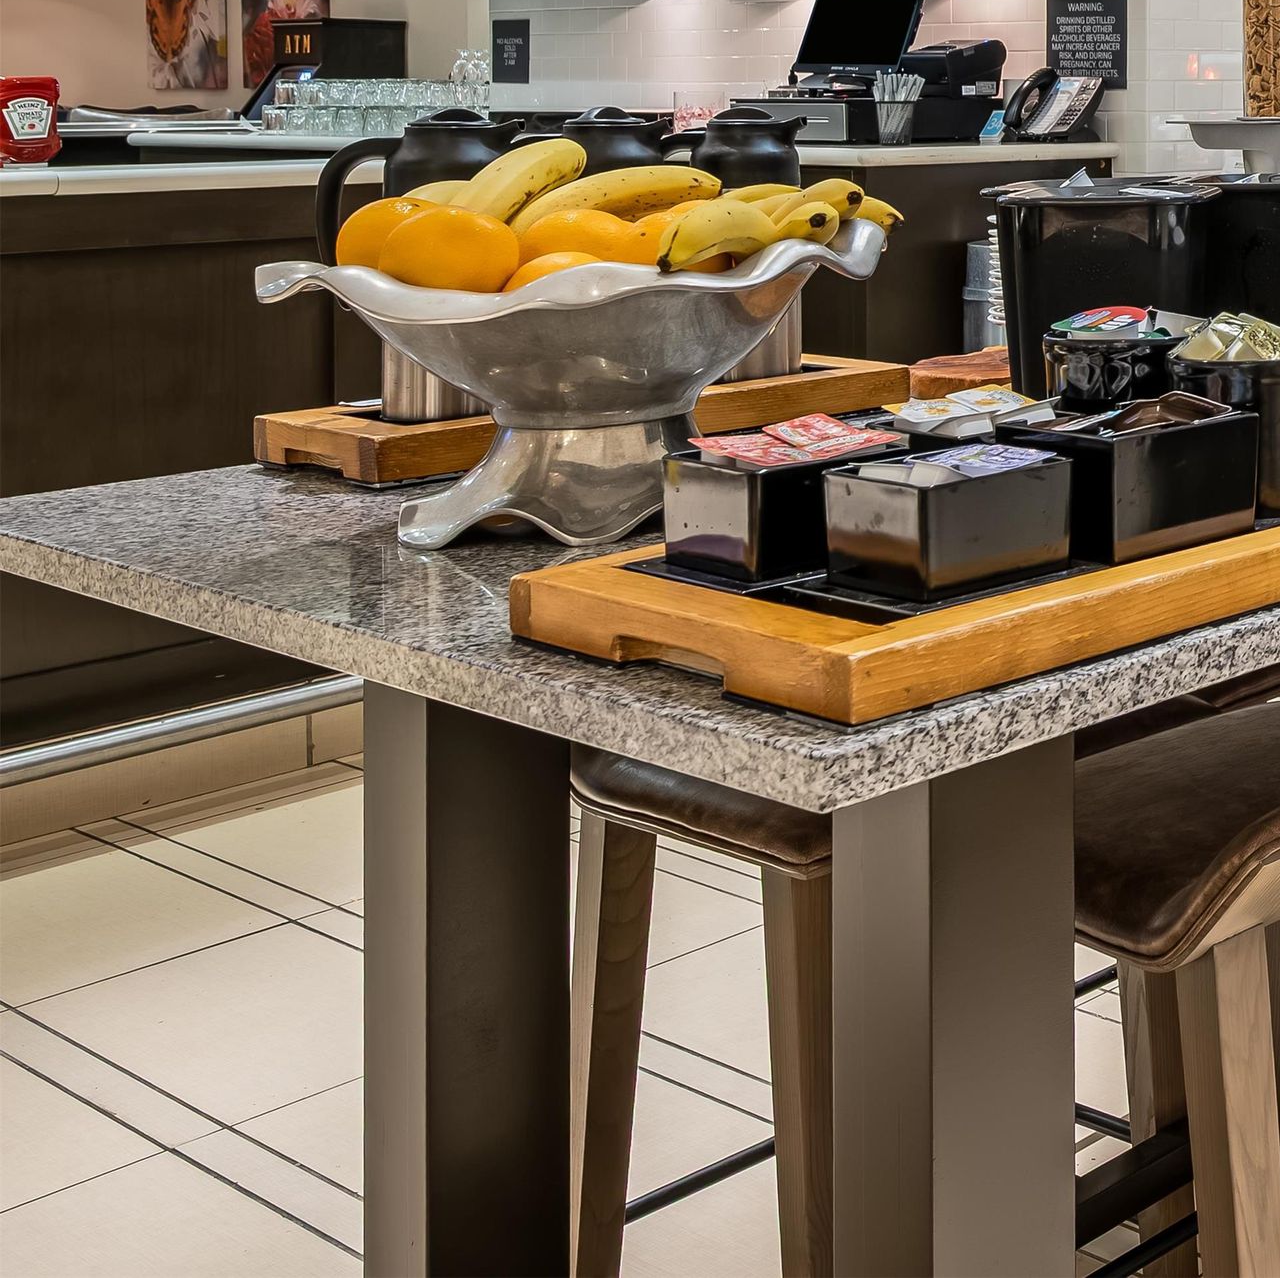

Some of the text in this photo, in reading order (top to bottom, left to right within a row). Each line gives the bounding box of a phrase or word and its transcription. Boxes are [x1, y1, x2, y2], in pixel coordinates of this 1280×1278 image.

[1068, 3, 1104, 11] WARNING:
[1086, 16, 1115, 24] DISTILLED
[1092, 25, 1112, 33] OTHER
[1052, 34, 1121, 42] ALCOHOLIC BEVERAGES
[285, 34, 310, 54] ATM
